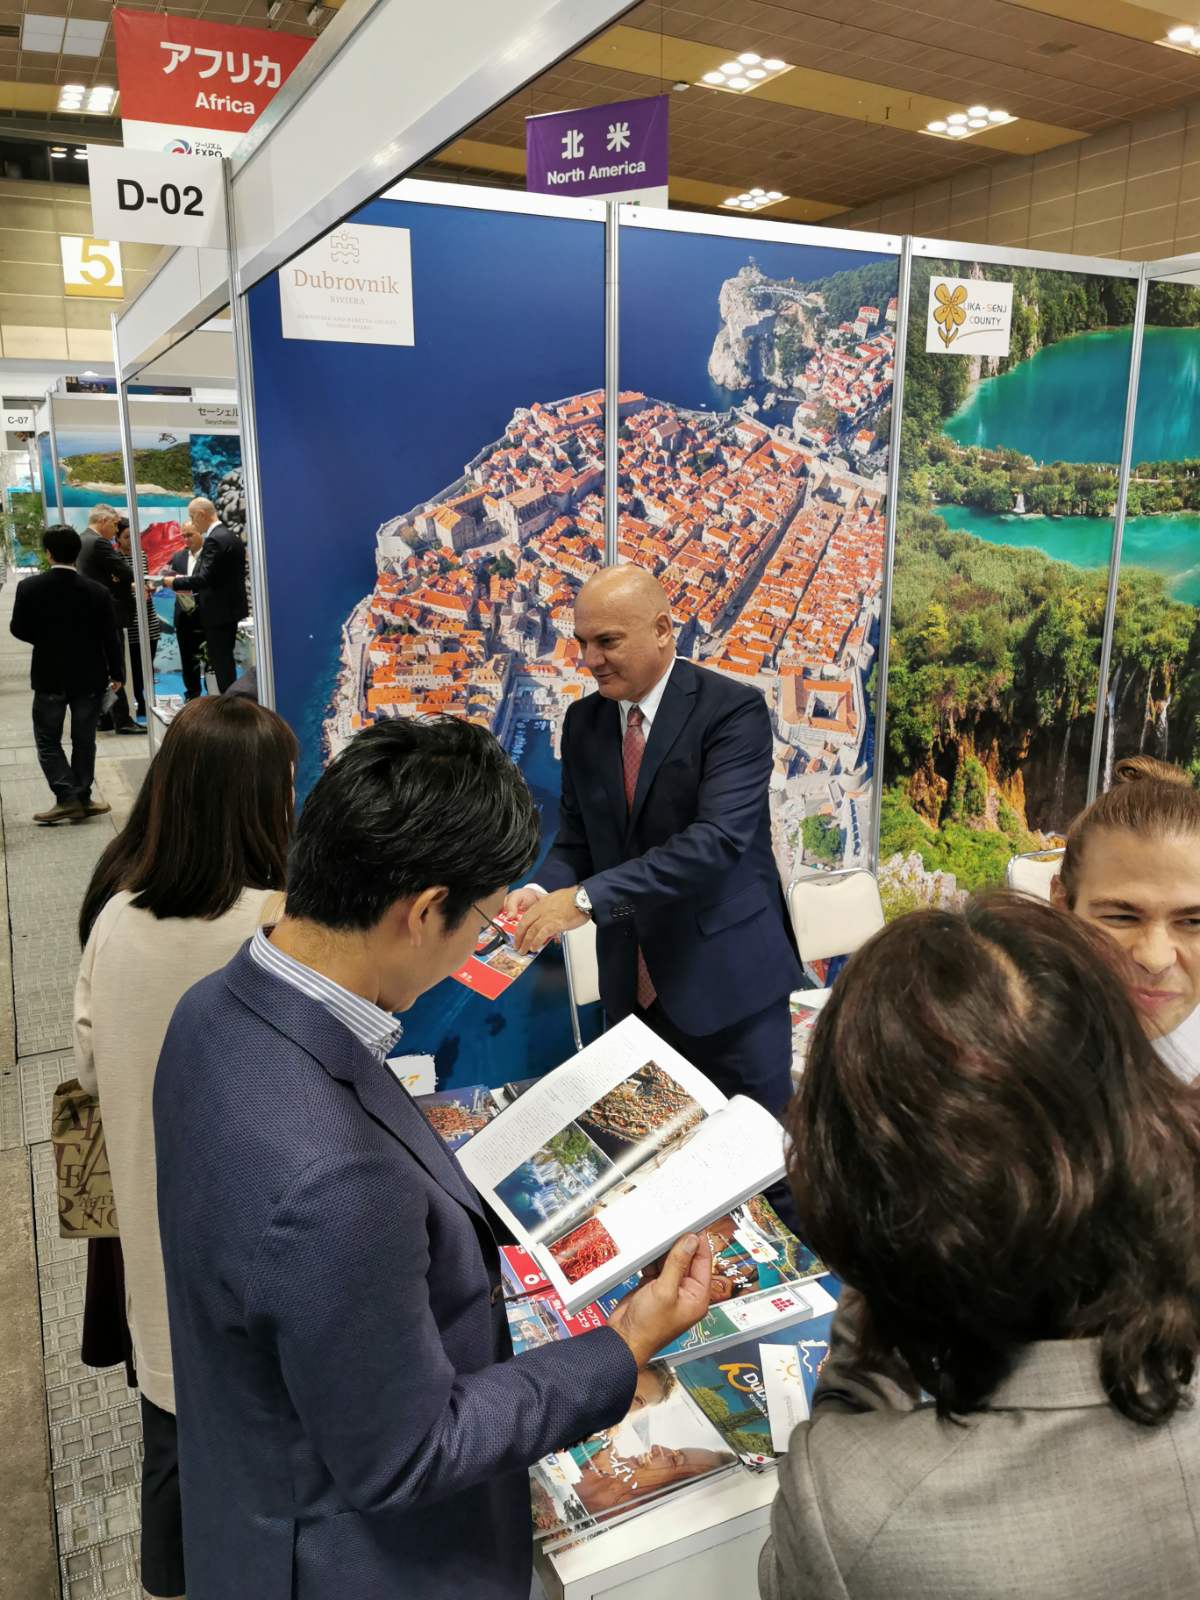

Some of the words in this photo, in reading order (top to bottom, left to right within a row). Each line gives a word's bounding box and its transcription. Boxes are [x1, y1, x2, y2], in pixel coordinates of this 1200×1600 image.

[160, 41, 281, 88] アフリカ
[195, 92, 255, 115] Africa
[547, 168, 585, 185] North
[588, 161, 646, 179] America
[117, 178, 204, 217] D-02
[79, 239, 115, 285] 5
[293, 269, 399, 294] Dubrovnik
[969, 316, 1001, 326] COUNTY
[8, 416, 29, 424] C-07
